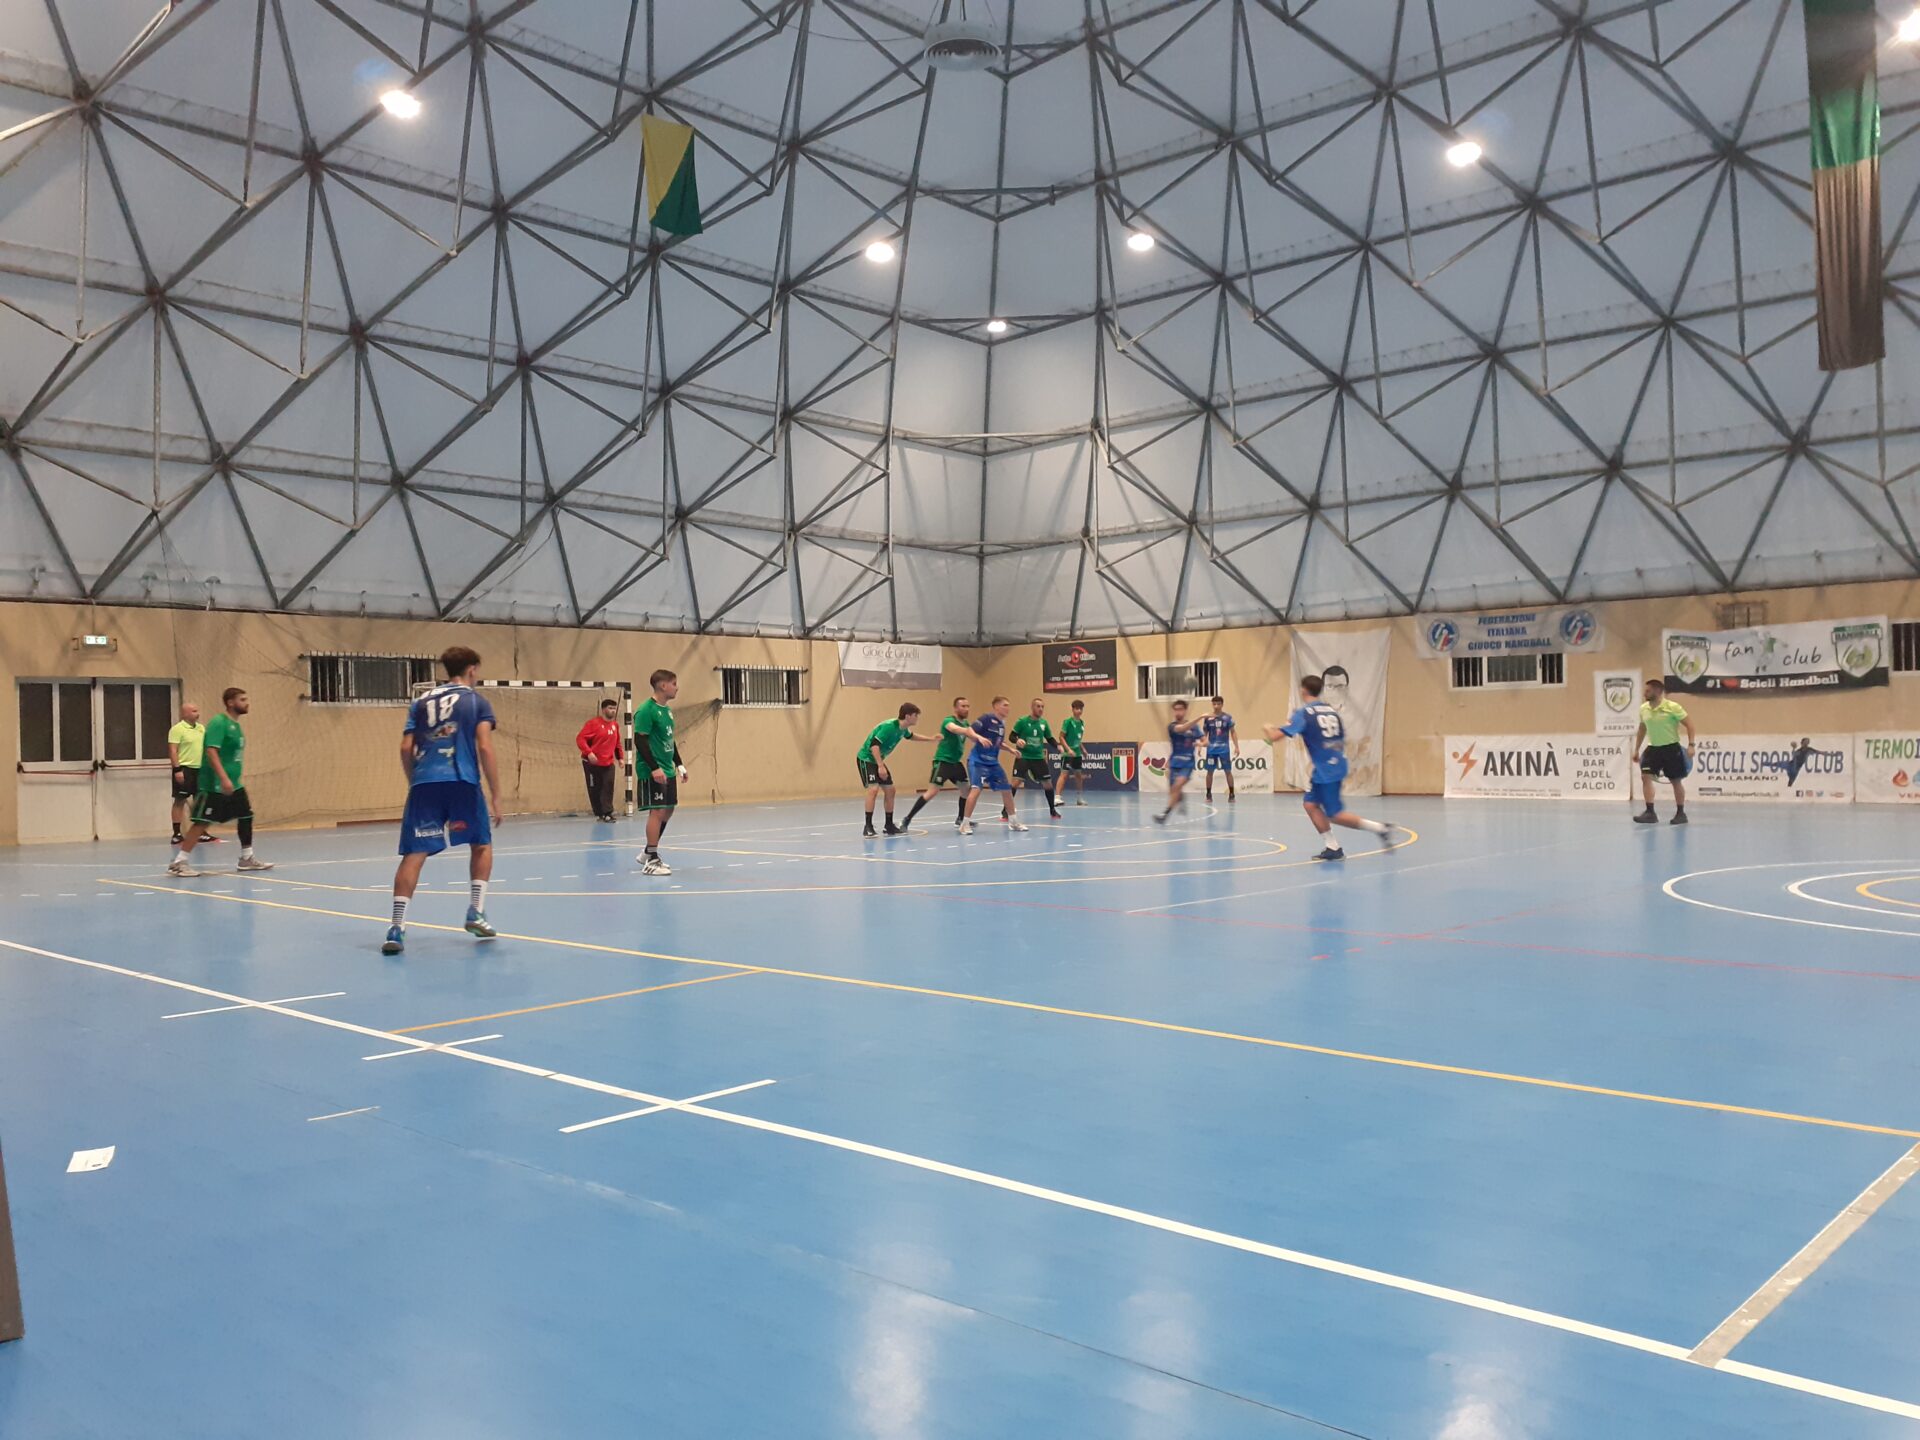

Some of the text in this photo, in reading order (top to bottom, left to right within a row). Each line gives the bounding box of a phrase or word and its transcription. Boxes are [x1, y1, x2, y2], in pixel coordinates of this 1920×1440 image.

[1478, 613, 1536, 625] FEDERAZIONE
[1487, 627, 1527, 637] ITALIANA
[1468, 638, 1552, 651] GIUOCO HANDBALL
[1783, 646, 1822, 666] club
[1740, 678, 1776, 689] Scicli
[1779, 674, 1840, 688] Handball
[426, 693, 460, 728] 18
[1566, 747, 1622, 756] PALESTRA
[1483, 742, 1560, 777] AKINÀ
[1583, 759, 1605, 767] BAR
[1697, 751, 1745, 774] SCICLI
[1804, 751, 1844, 774] CLUB
[1081, 762, 1107, 770] ANDBALL
[1576, 770, 1611, 779] PADEL
[1573, 782, 1616, 790] CALCIO
[654, 792, 664, 801] 34
